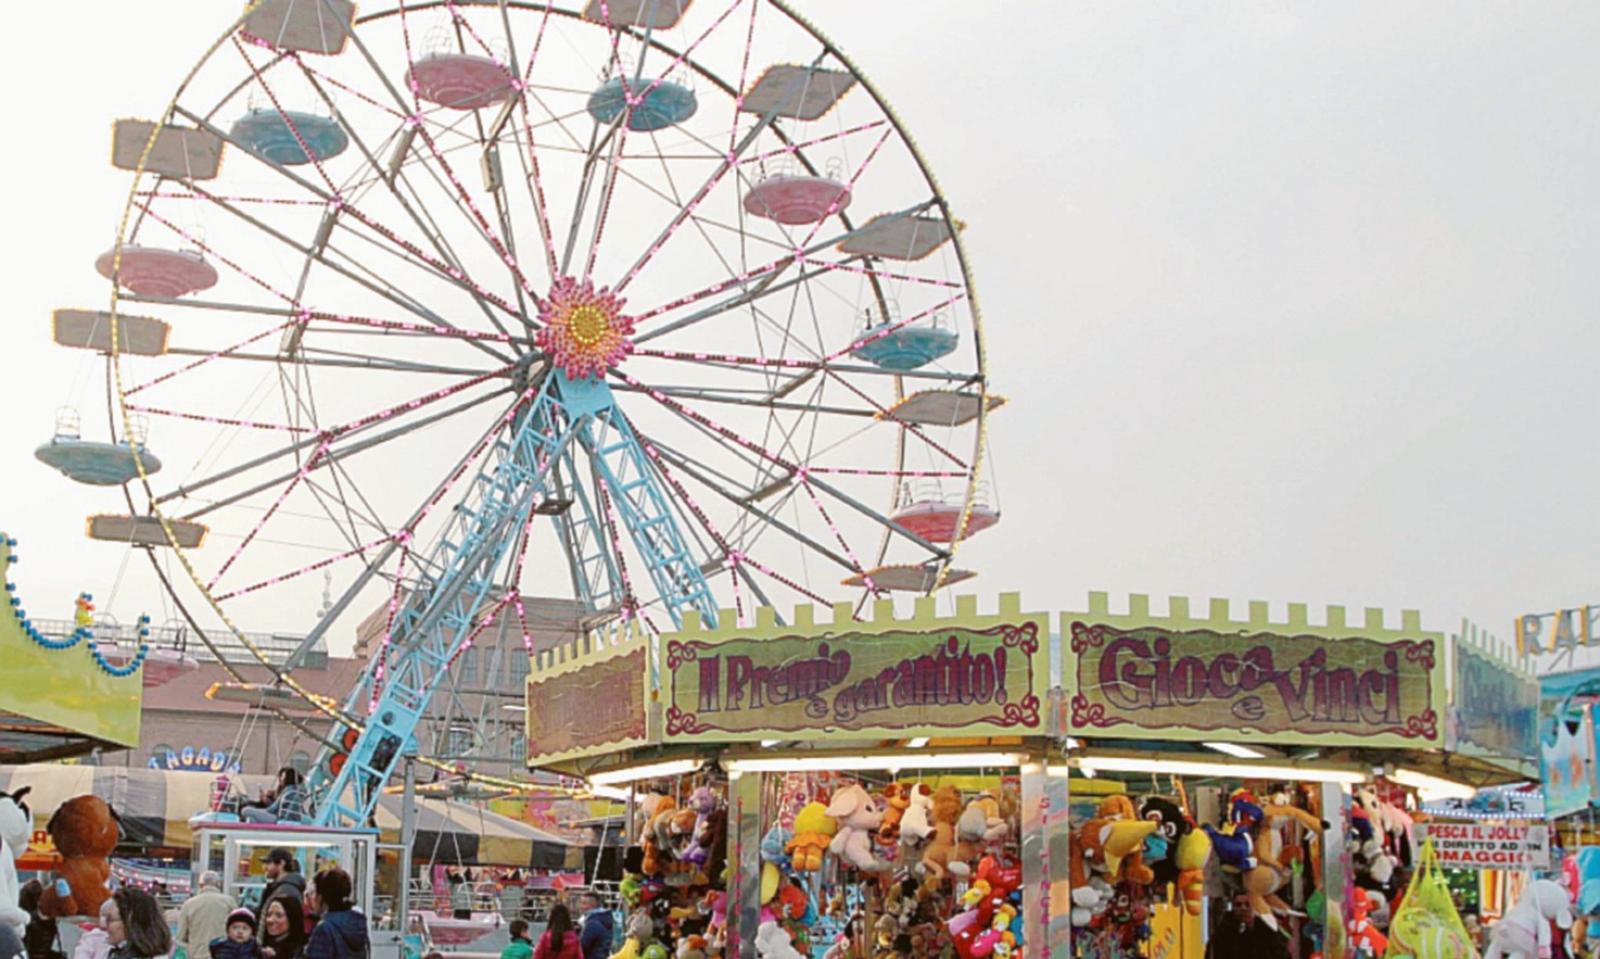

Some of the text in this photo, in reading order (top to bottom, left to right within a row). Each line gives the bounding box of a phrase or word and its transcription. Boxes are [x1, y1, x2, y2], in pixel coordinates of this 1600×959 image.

[697, 653, 721, 714] Il
[725, 642, 852, 712] Premio
[833, 634, 1007, 722] garantito!
[1100, 637, 1275, 711] Gioca
[1271, 647, 1402, 724] Vinci
[1427, 825, 1468, 839] PESCA
[1472, 826, 1485, 839] IL
[1443, 841, 1496, 850] DIRITTO
[1500, 842, 1519, 850] AD
